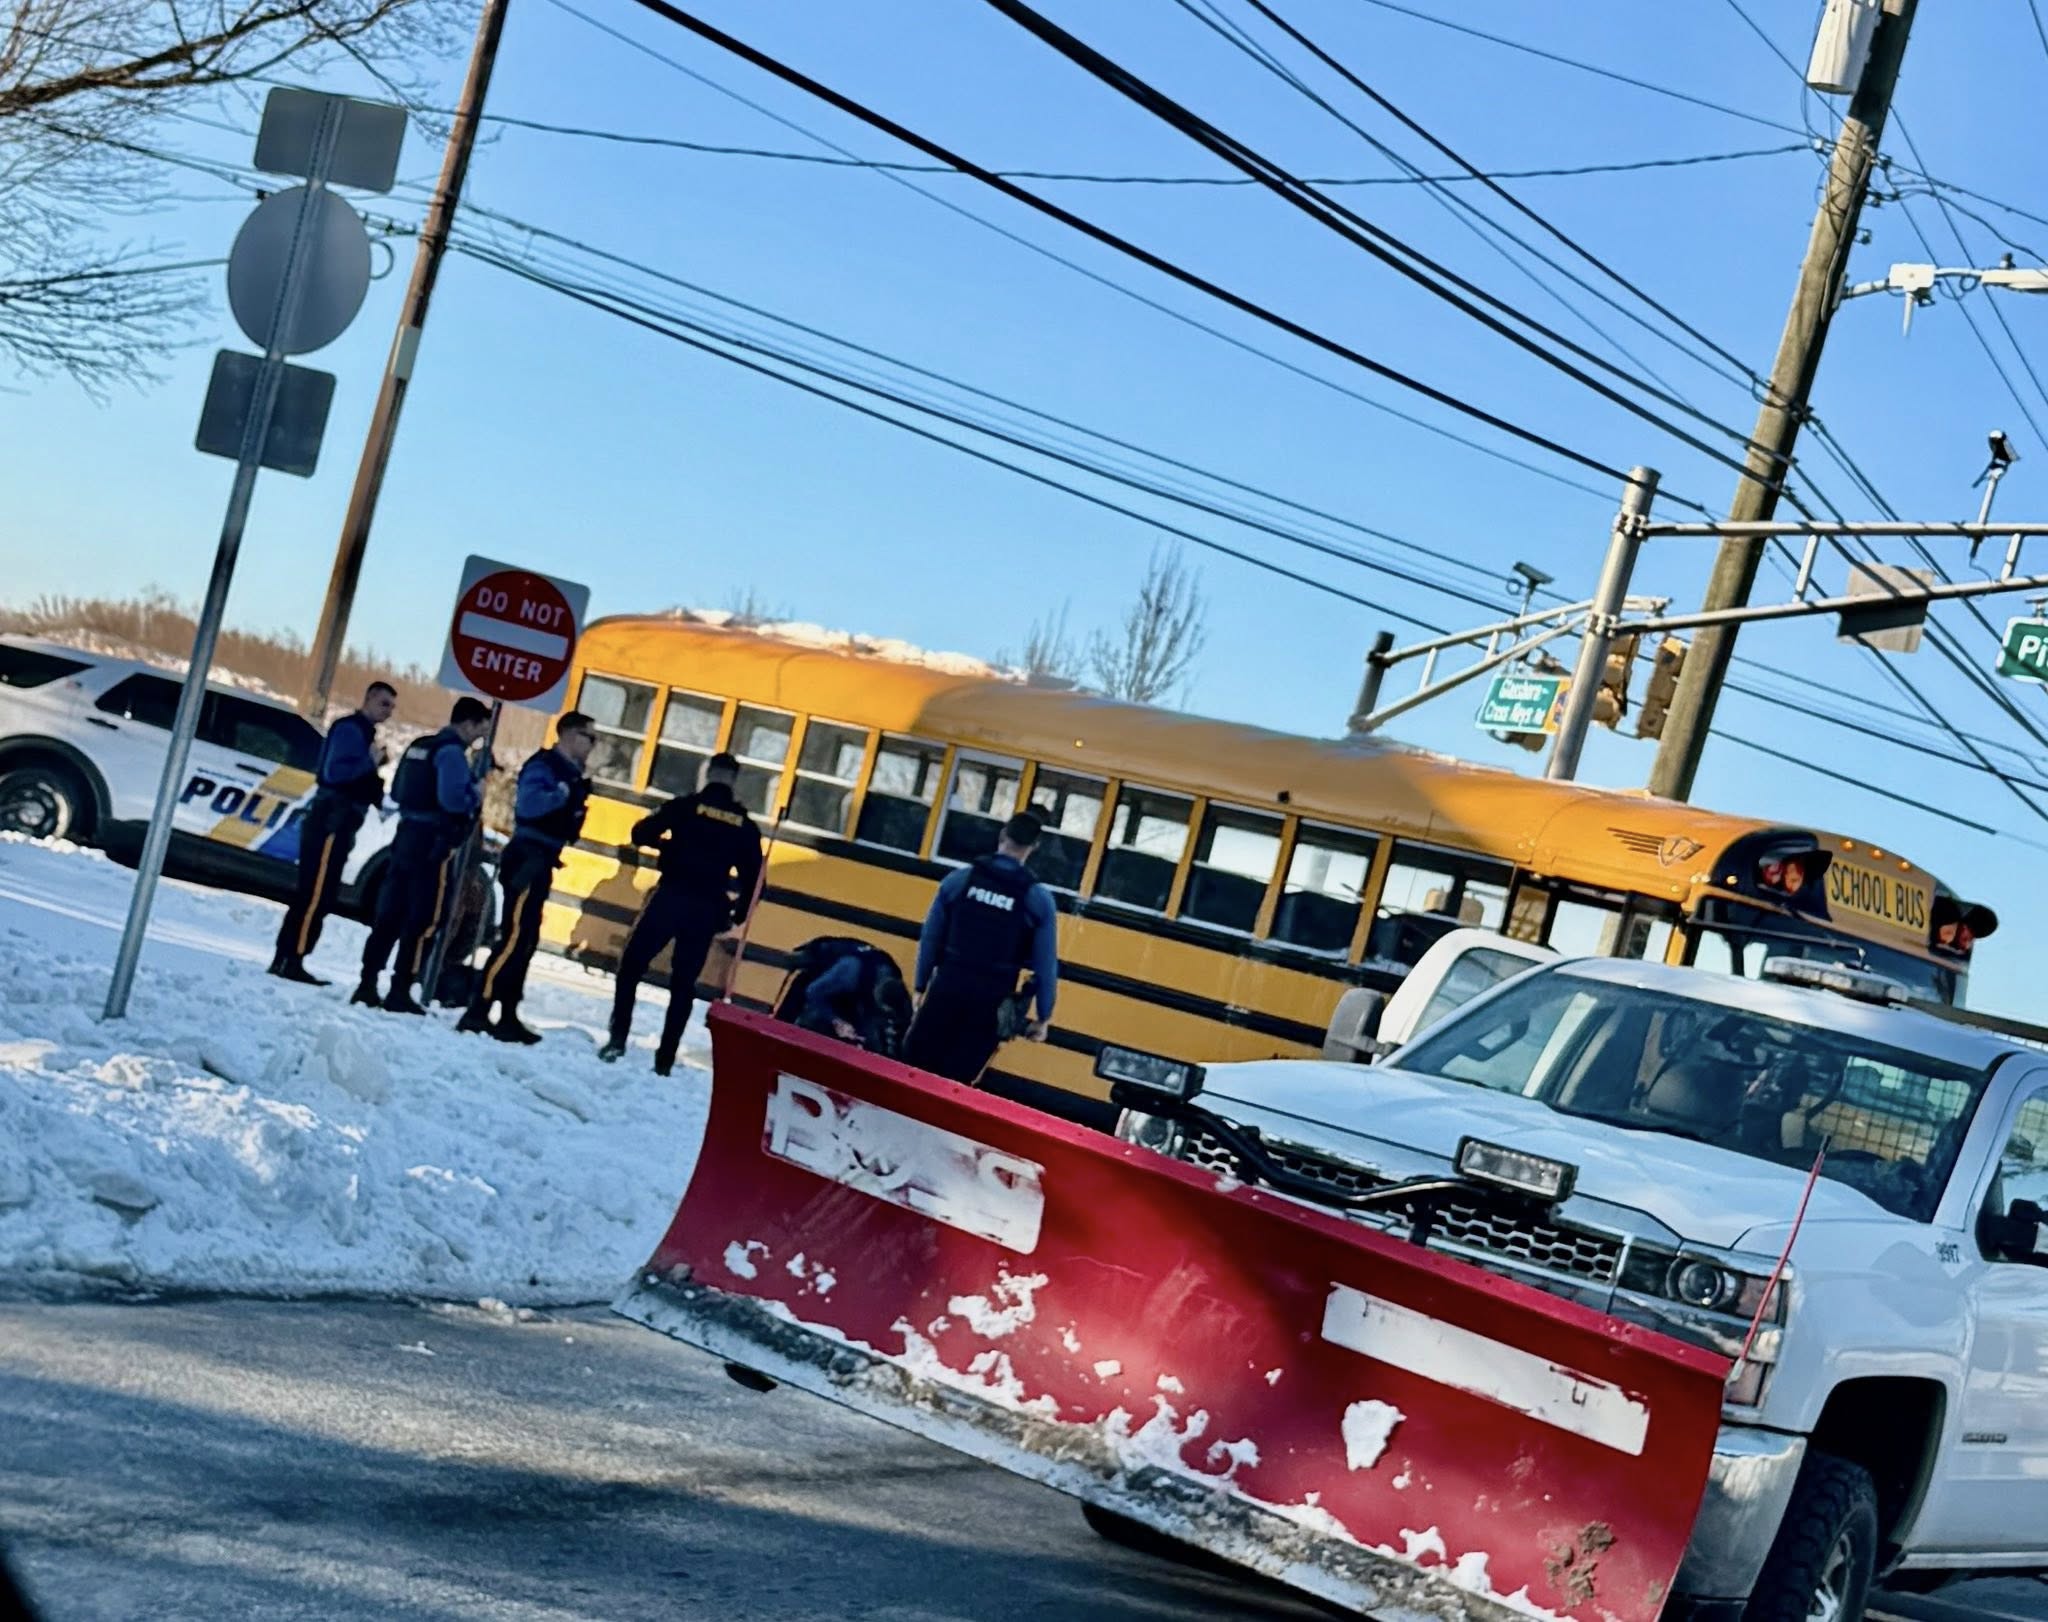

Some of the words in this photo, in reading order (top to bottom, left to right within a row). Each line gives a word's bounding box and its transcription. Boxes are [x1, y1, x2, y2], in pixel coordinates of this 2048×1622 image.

[476, 586, 508, 613] DO
[520, 598, 565, 628] NOT
[471, 646, 542, 683] ENTER
[2018, 634, 2048, 668] Pi
[967, 886, 1015, 911] POLICE
[1831, 862, 1891, 918] SCHOOL
[1895, 882, 1925, 929] BUS
